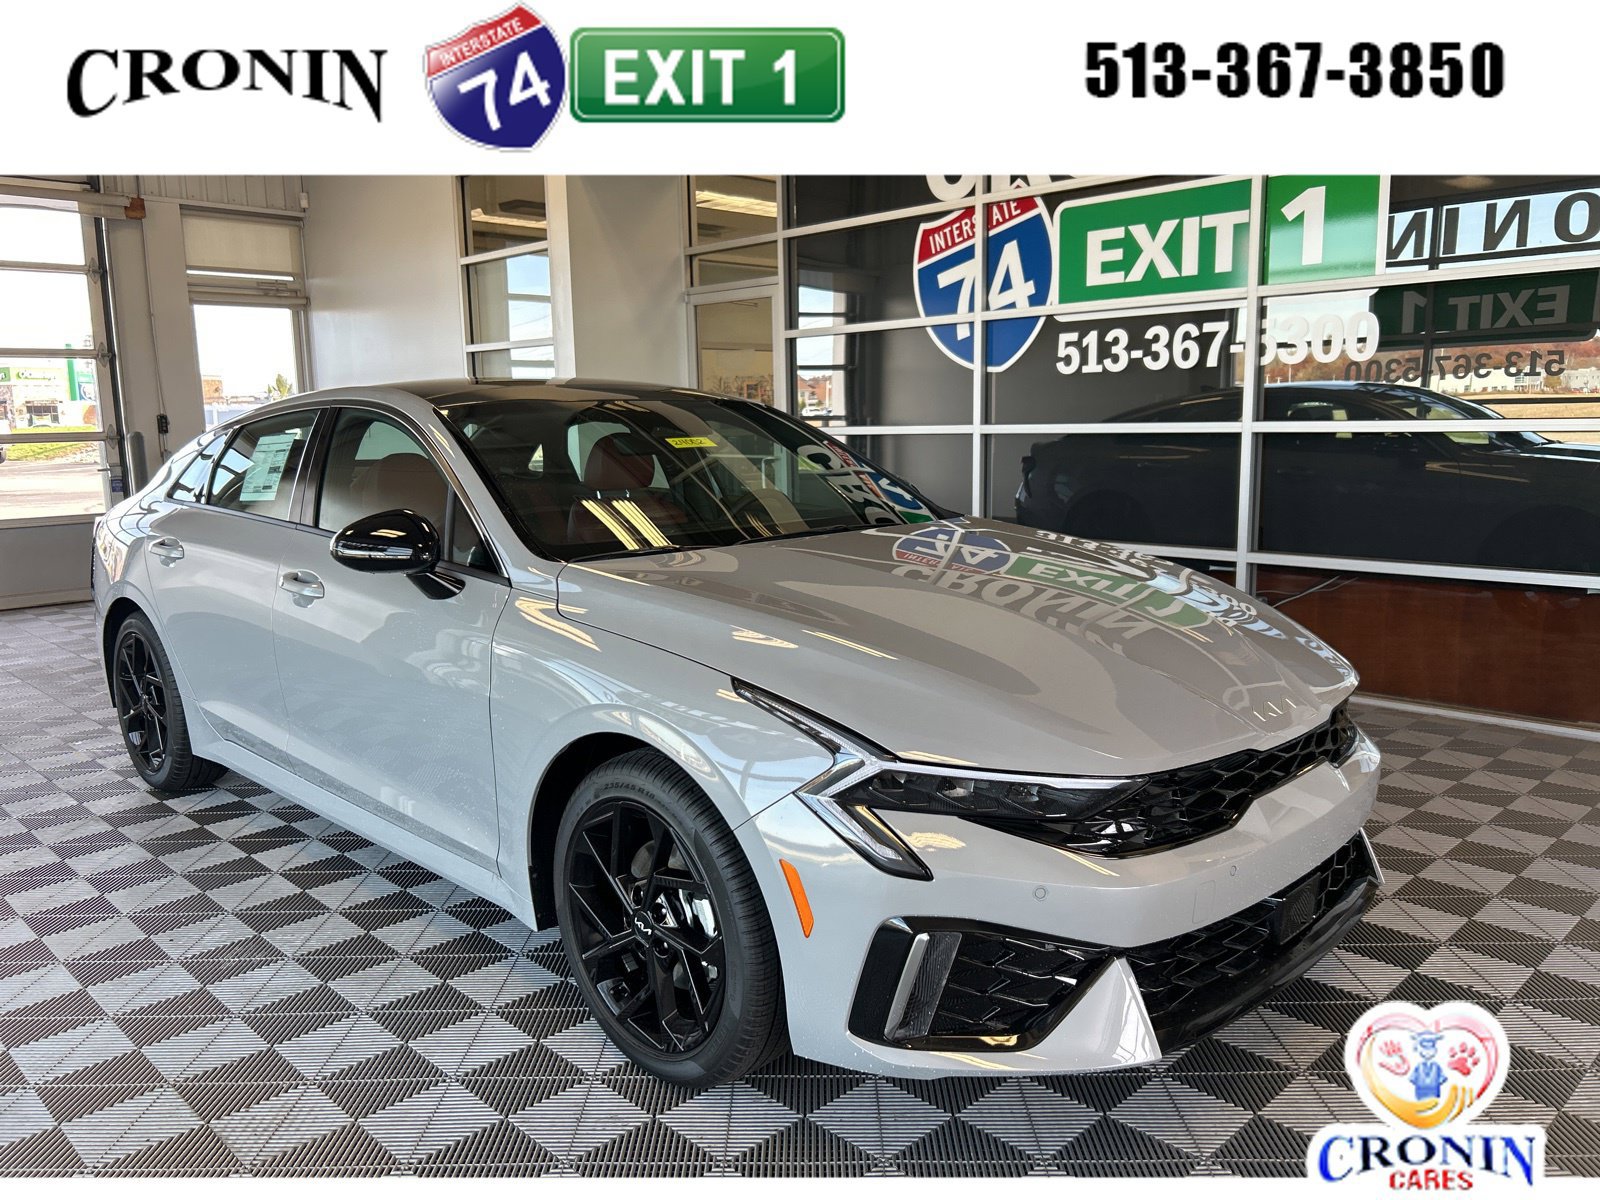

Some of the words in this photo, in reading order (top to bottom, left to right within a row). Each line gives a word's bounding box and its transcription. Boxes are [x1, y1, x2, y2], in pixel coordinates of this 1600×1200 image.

[928, 200, 1022, 255] INTERSATE
[1086, 209, 1249, 287] EXIT
[1280, 185, 1326, 266] 1
[937, 239, 1036, 341] 74
